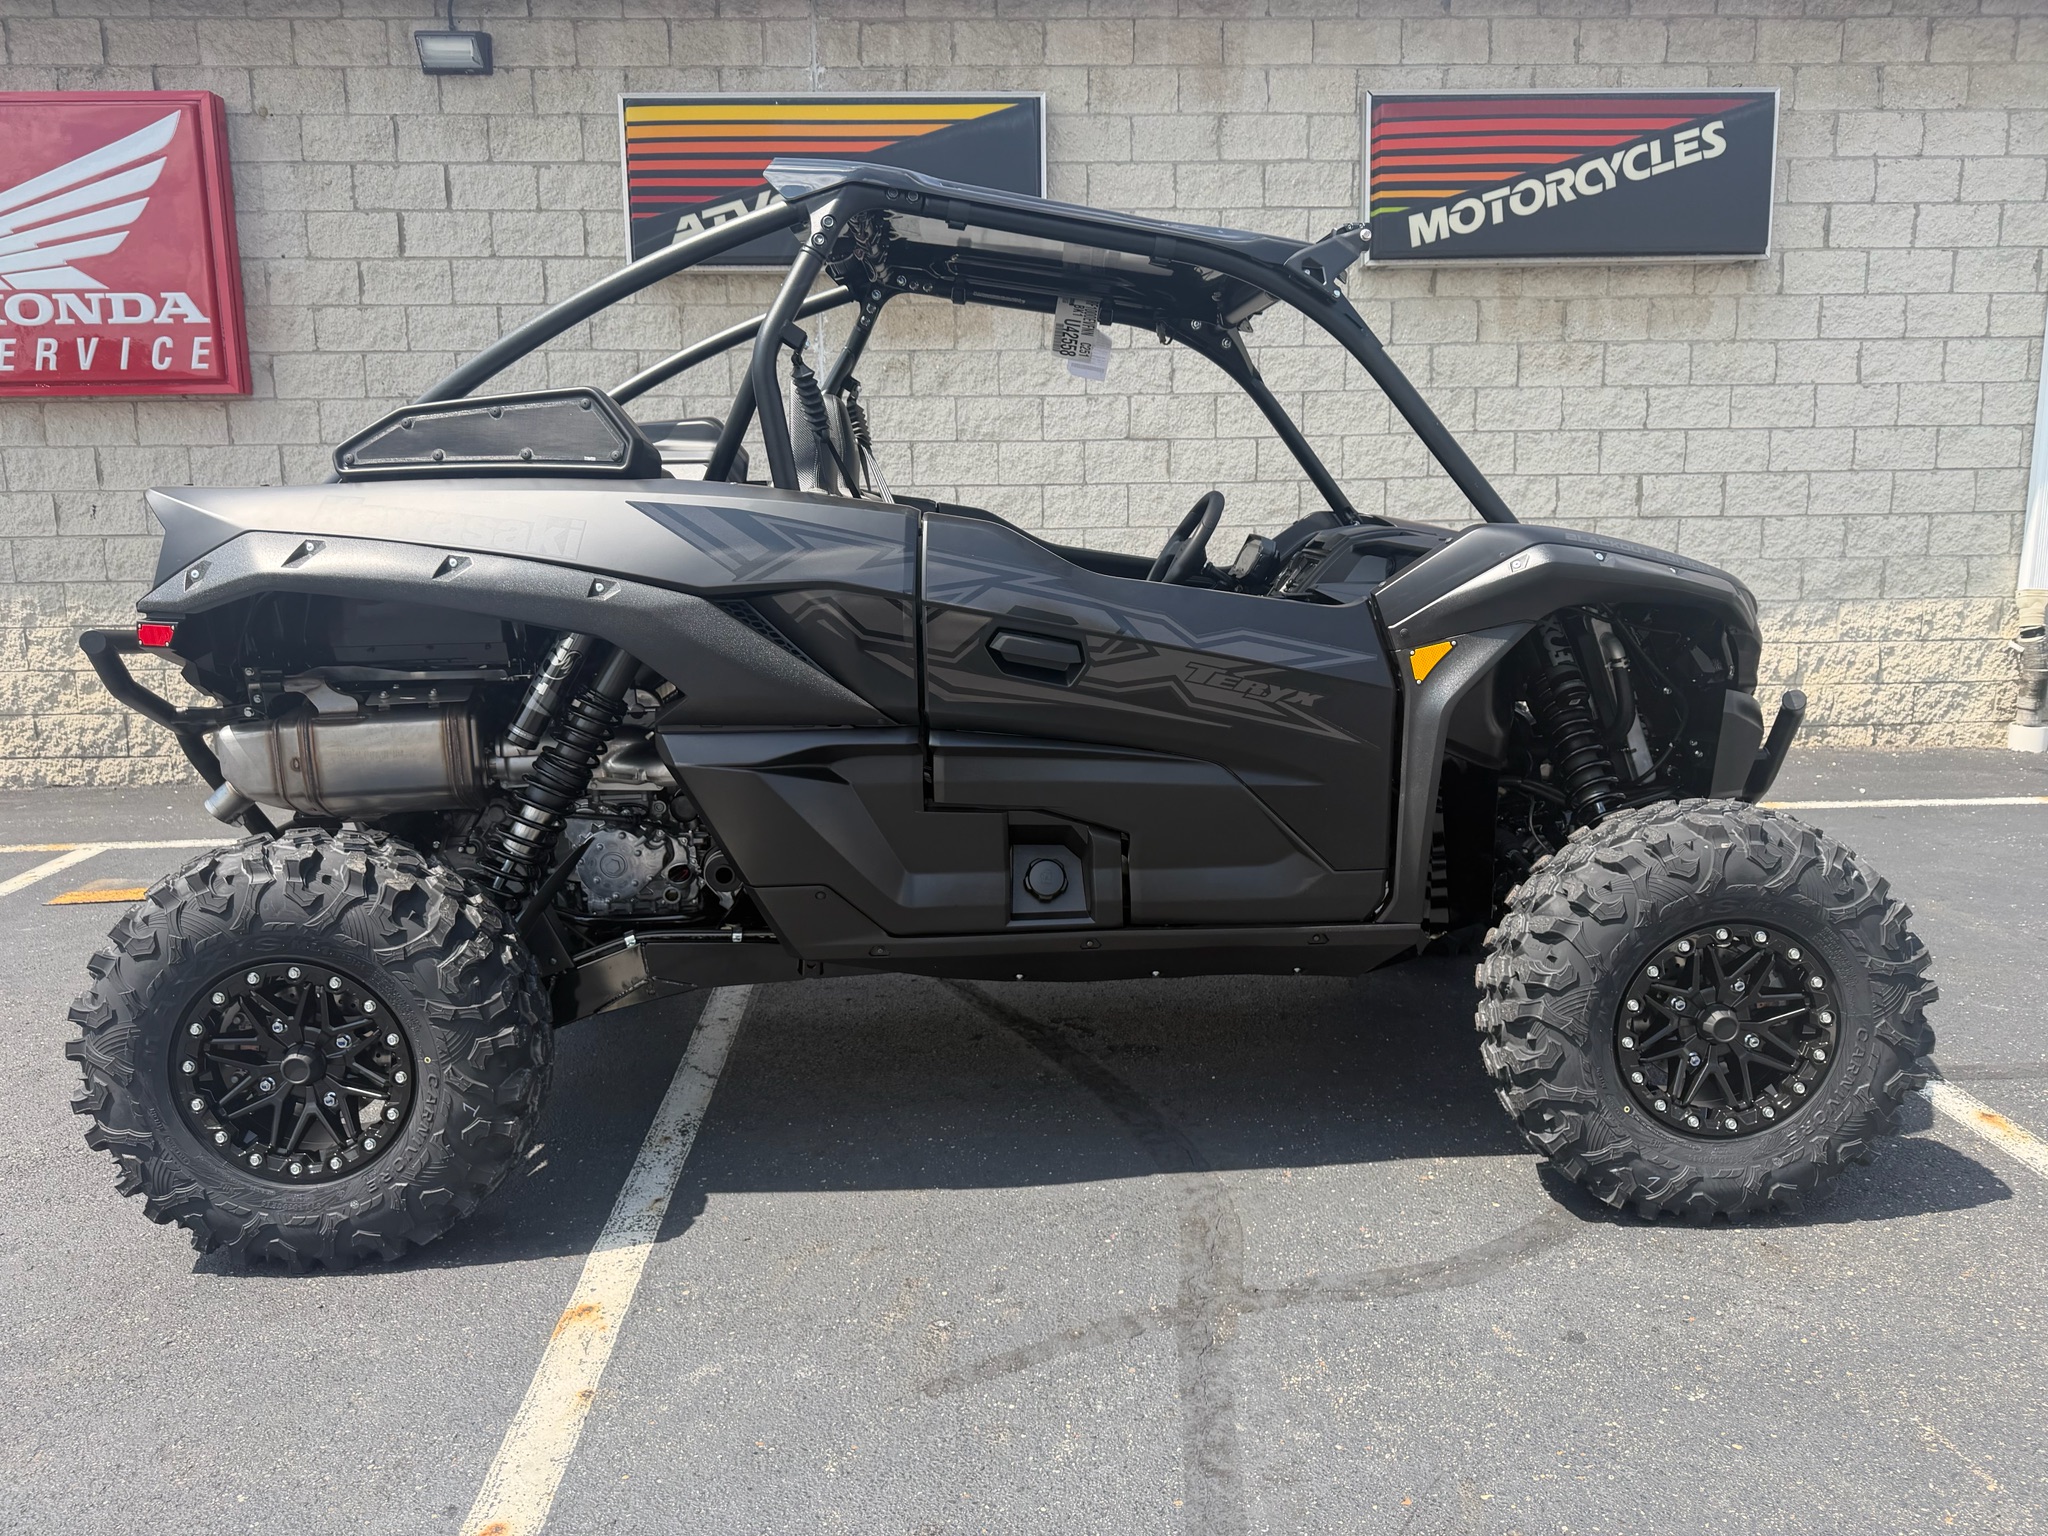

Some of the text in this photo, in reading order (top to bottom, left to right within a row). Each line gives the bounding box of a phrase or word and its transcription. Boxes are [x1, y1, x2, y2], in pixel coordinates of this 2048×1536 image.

[1408, 119, 1728, 248] MOTORCYCLES
[671, 189, 790, 246] ATV
[0, 292, 211, 326] ONDA
[0, 337, 212, 371] ERVICE
[1059, 318, 1082, 357] U42558
[1564, 532, 1712, 572] BLACKOUT EDITION
[1787, 1027, 1869, 1146] CARNIVORE
[366, 1072, 438, 1193] CARNIVORE
